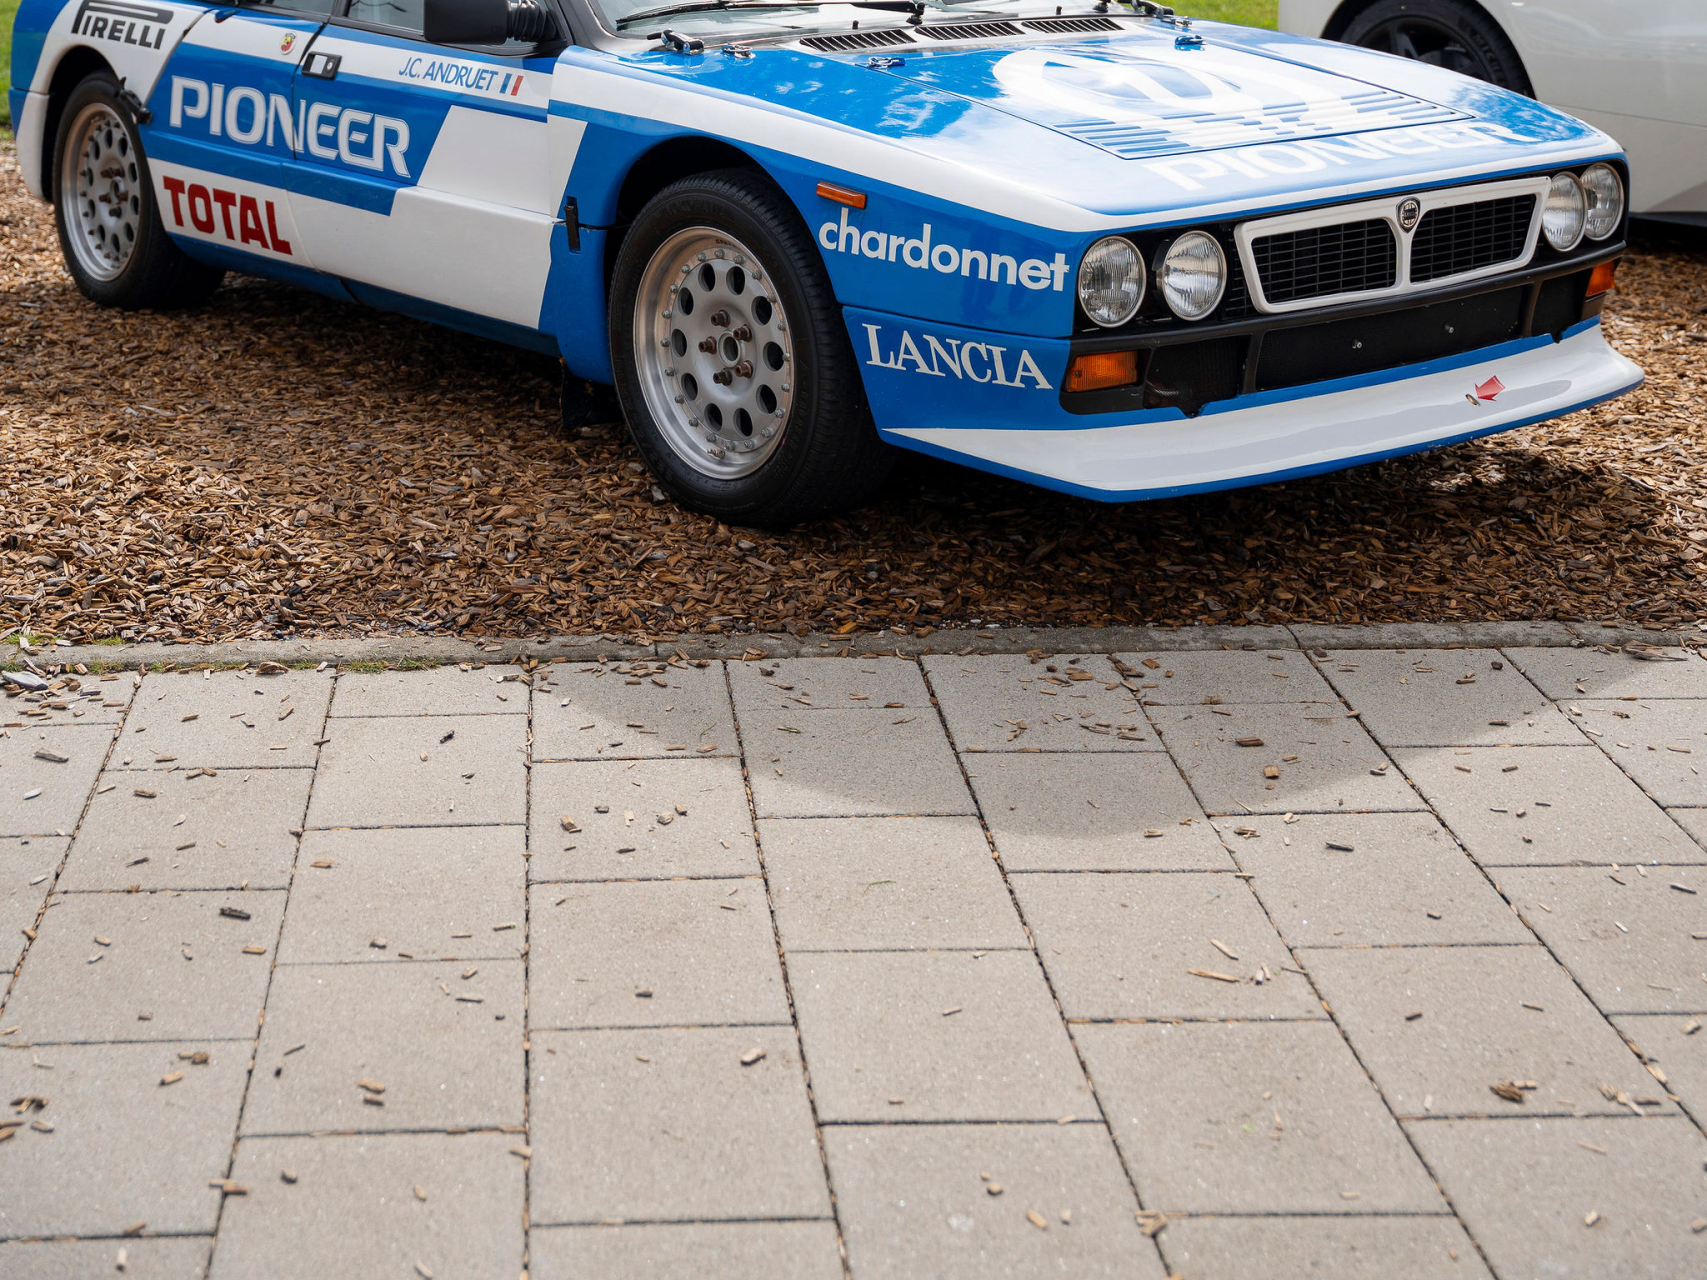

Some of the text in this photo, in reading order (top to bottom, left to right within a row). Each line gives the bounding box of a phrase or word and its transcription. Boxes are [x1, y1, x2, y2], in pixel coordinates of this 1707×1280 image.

[398, 57, 498, 91] J.C. ANDRUET
[169, 75, 411, 178] PIONEER
[1142, 120, 1541, 192] PIONEER
[163, 175, 293, 255] TOTAL
[818, 207, 1070, 291] chardonnet
[862, 323, 1053, 389] LANCIA
